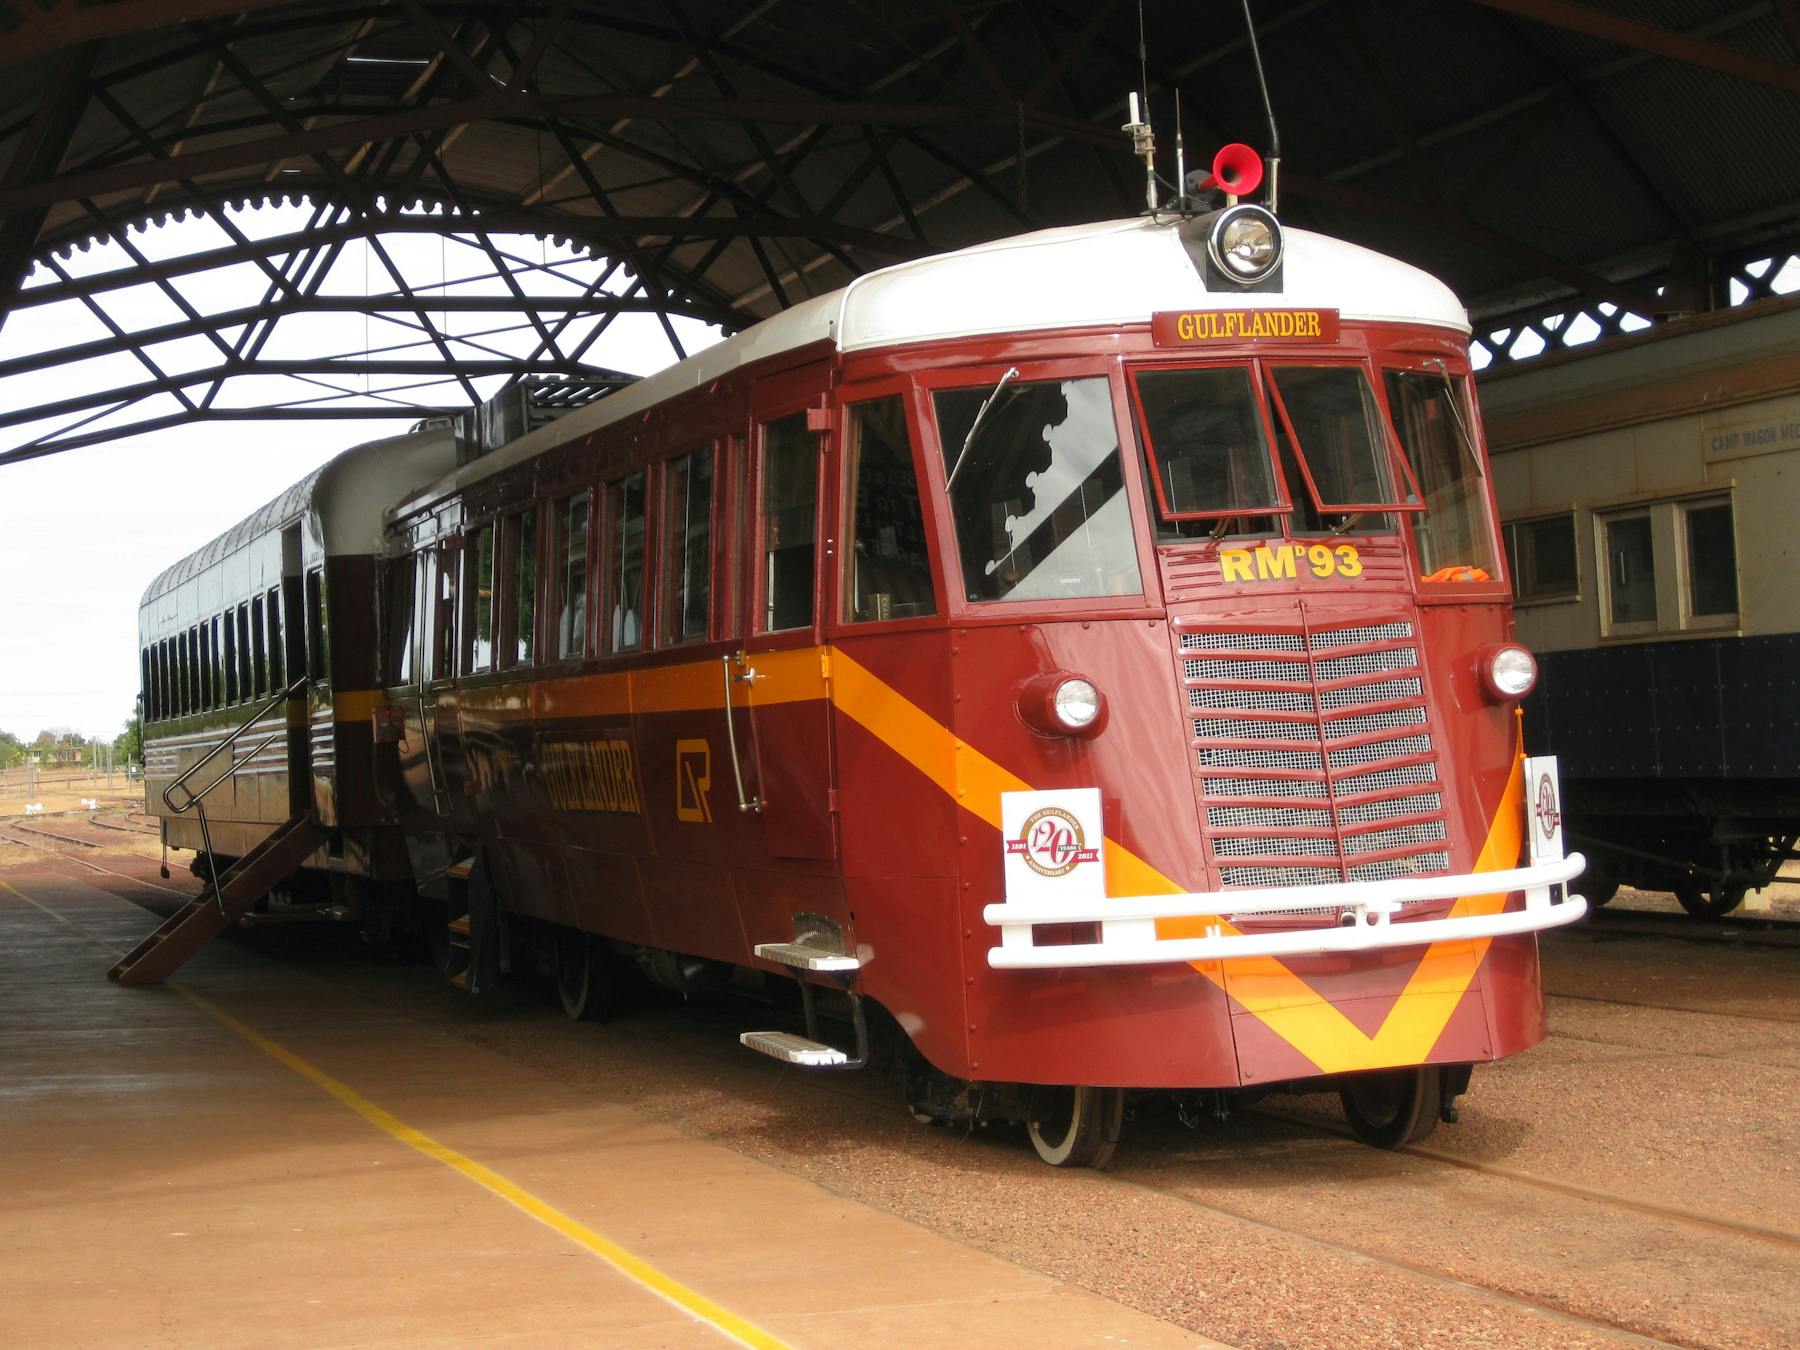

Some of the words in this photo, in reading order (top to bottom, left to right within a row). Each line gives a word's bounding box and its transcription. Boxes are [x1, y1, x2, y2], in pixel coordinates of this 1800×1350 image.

[1177, 311, 1322, 340] GULFLANDER
[1712, 431, 1739, 452] CAMP
[1743, 426, 1777, 448] WAGON
[1030, 811, 1043, 823] THE
[1042, 808, 1080, 831] GULFLANDER
[1033, 821, 1073, 864] 120
[1028, 859, 1065, 876] ANNIVERSARY
